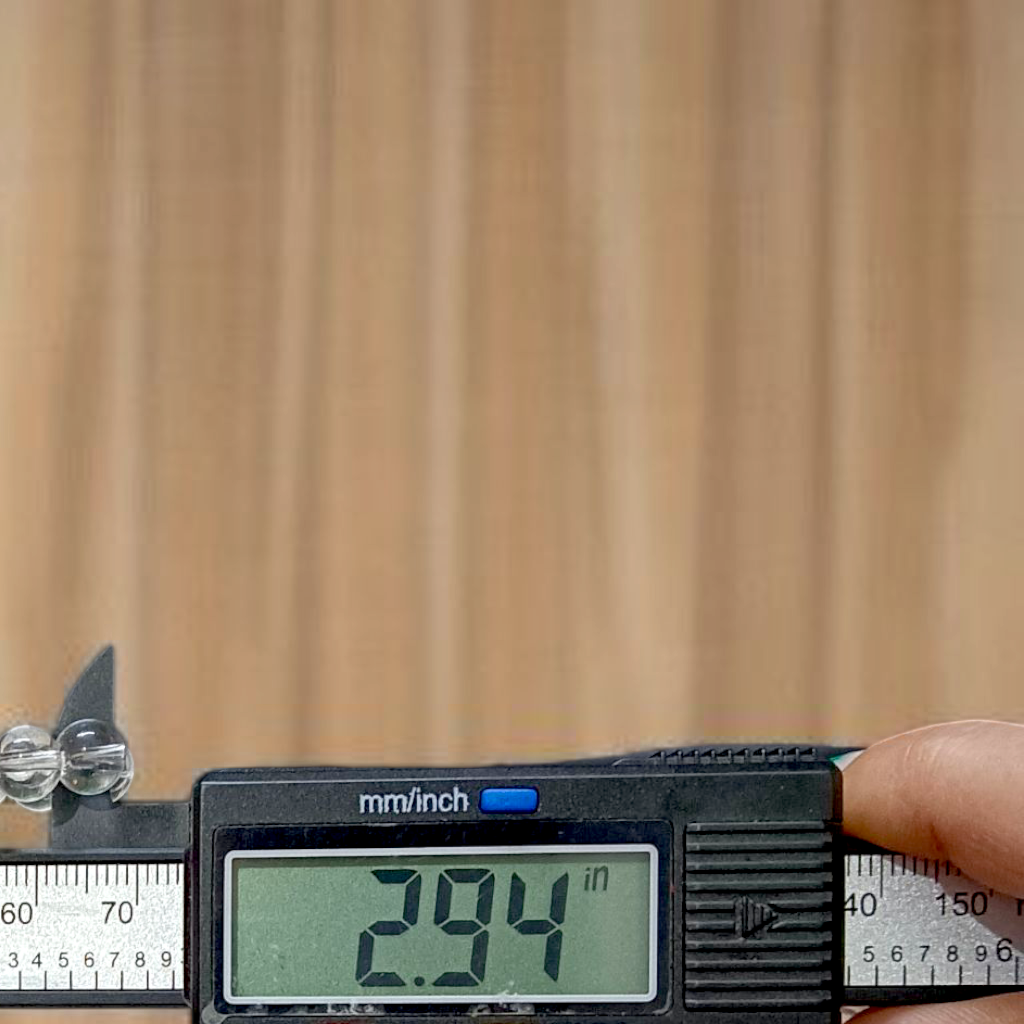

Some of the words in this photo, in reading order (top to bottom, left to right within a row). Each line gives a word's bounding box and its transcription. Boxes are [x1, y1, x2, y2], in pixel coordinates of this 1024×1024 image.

[359, 787, 470, 814] mm/inch
[1, 902, 33, 925] 60
[102, 901, 134, 923] 70
[844, 893, 877, 916] 40
[936, 892, 988, 915] 150
[355, 868, 569, 988] 2.94
[584, 865, 608, 892] in
[8, 952, 19, 968] 3
[31, 952, 42, 968] 4
[59, 952, 69, 967] 5
[84, 952, 94, 967] 6
[110, 952, 120, 967] 7
[135, 952, 145, 967] 8
[161, 952, 172, 967] 9
[863, 946, 874, 962] 5
[891, 946, 903, 962] 6
[920, 946, 929, 961] 7
[947, 946, 958, 961] 8
[976, 946, 987, 961] 9
[996, 938, 1012, 961] 6
